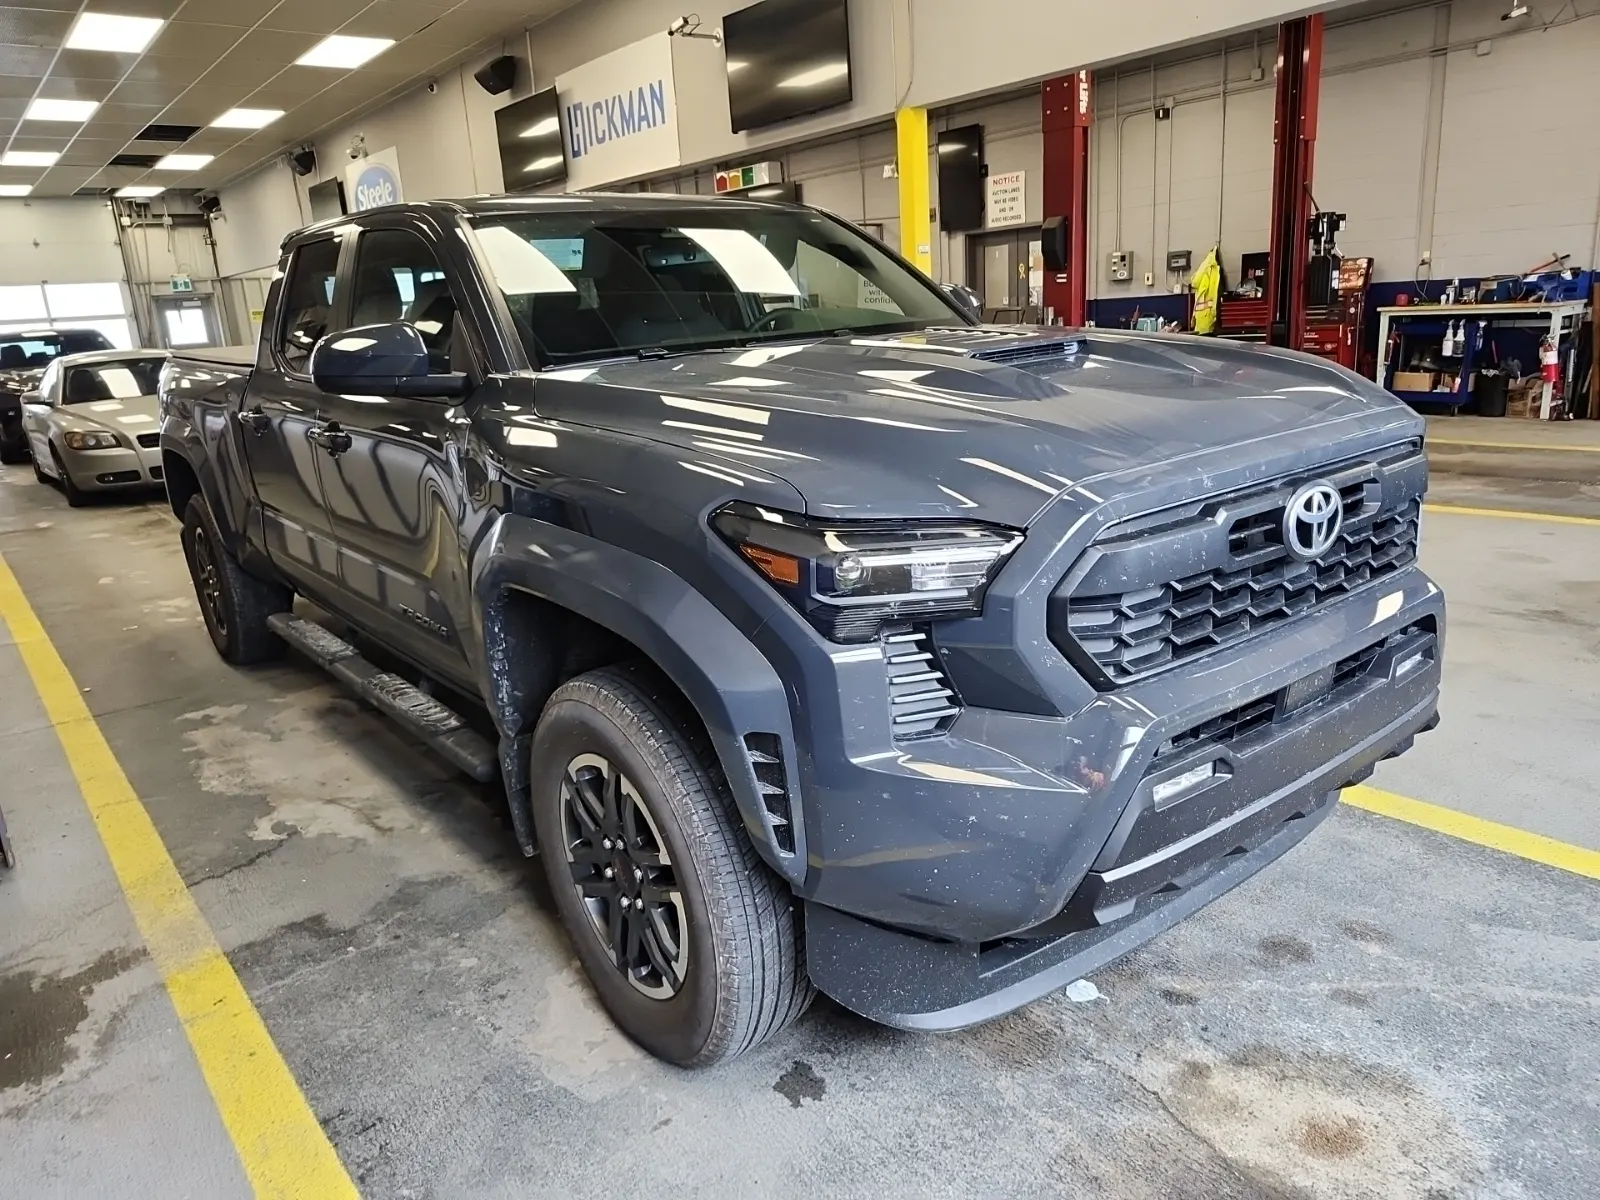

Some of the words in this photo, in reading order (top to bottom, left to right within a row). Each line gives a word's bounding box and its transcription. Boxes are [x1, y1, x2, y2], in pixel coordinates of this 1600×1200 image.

[567, 80, 665, 158] HICKMAN
[357, 178, 393, 211] Steele
[992, 175, 1020, 186] NOTICE
[399, 603, 448, 639] TACOMA
